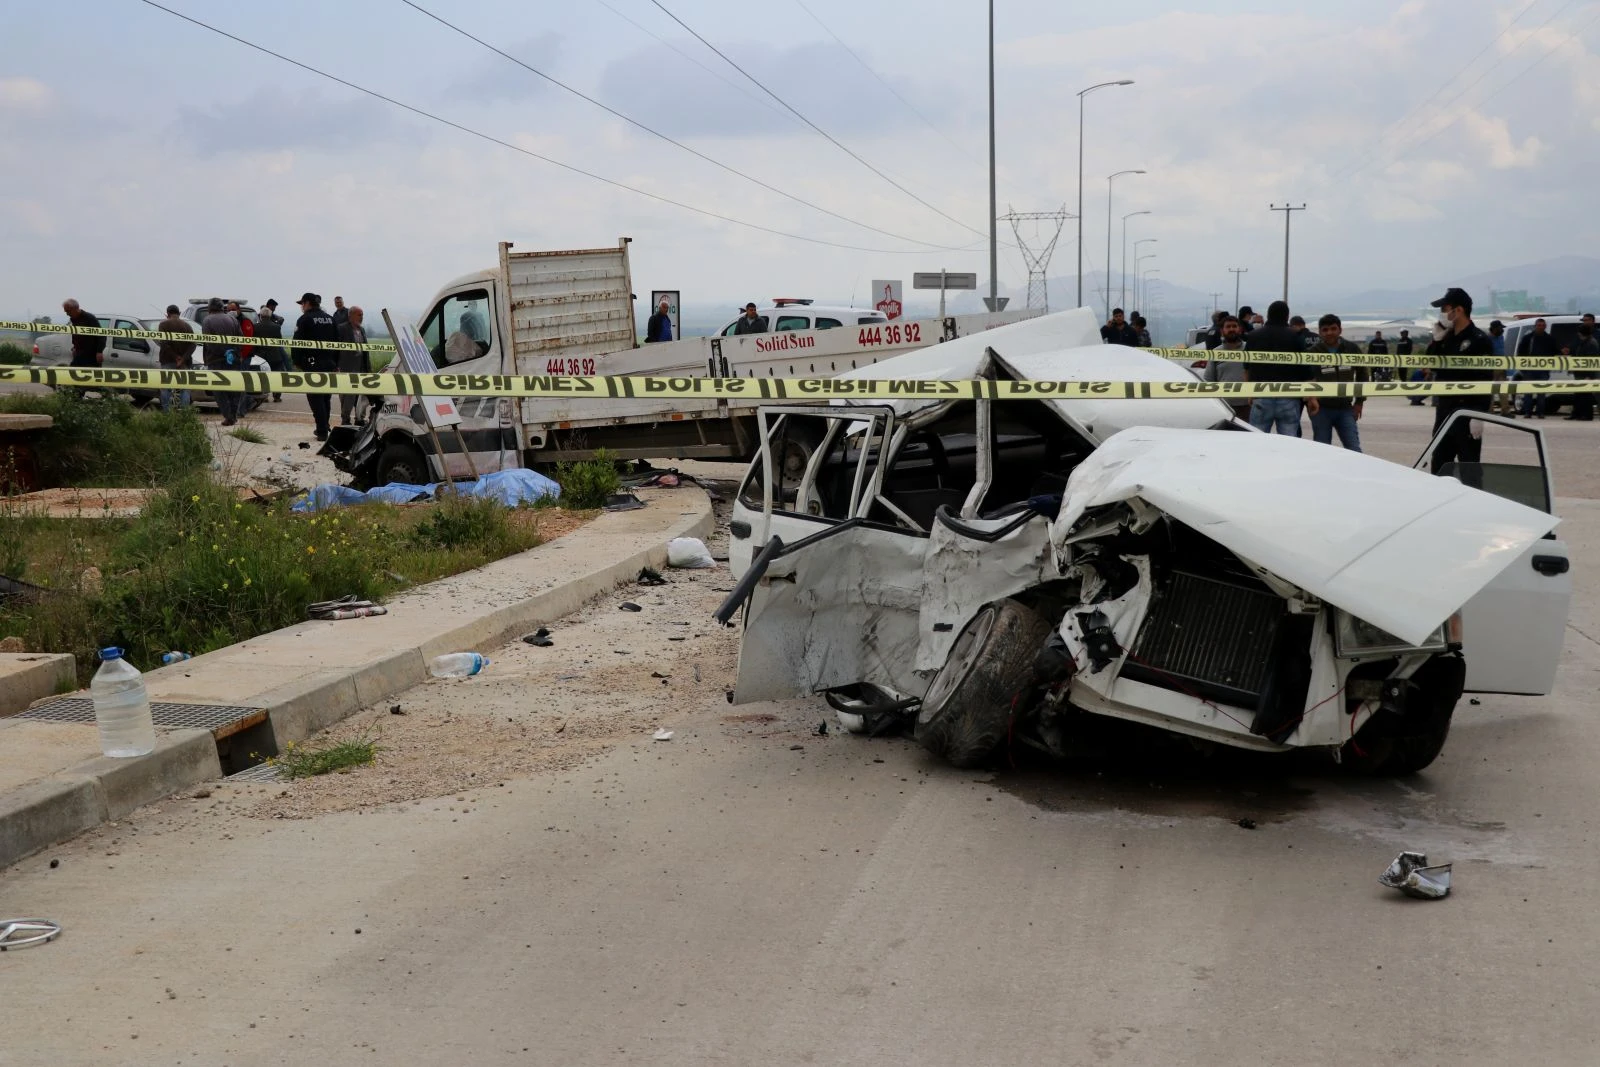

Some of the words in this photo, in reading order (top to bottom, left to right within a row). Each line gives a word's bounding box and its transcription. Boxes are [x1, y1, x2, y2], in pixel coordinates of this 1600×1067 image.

[755, 334, 815, 353] SolidSun
[858, 326, 882, 347] 444
[885, 325, 901, 345] 36
[904, 323, 921, 343] 92
[546, 359, 565, 375] 444
[567, 358, 580, 375] 36
[583, 358, 596, 375] 92
